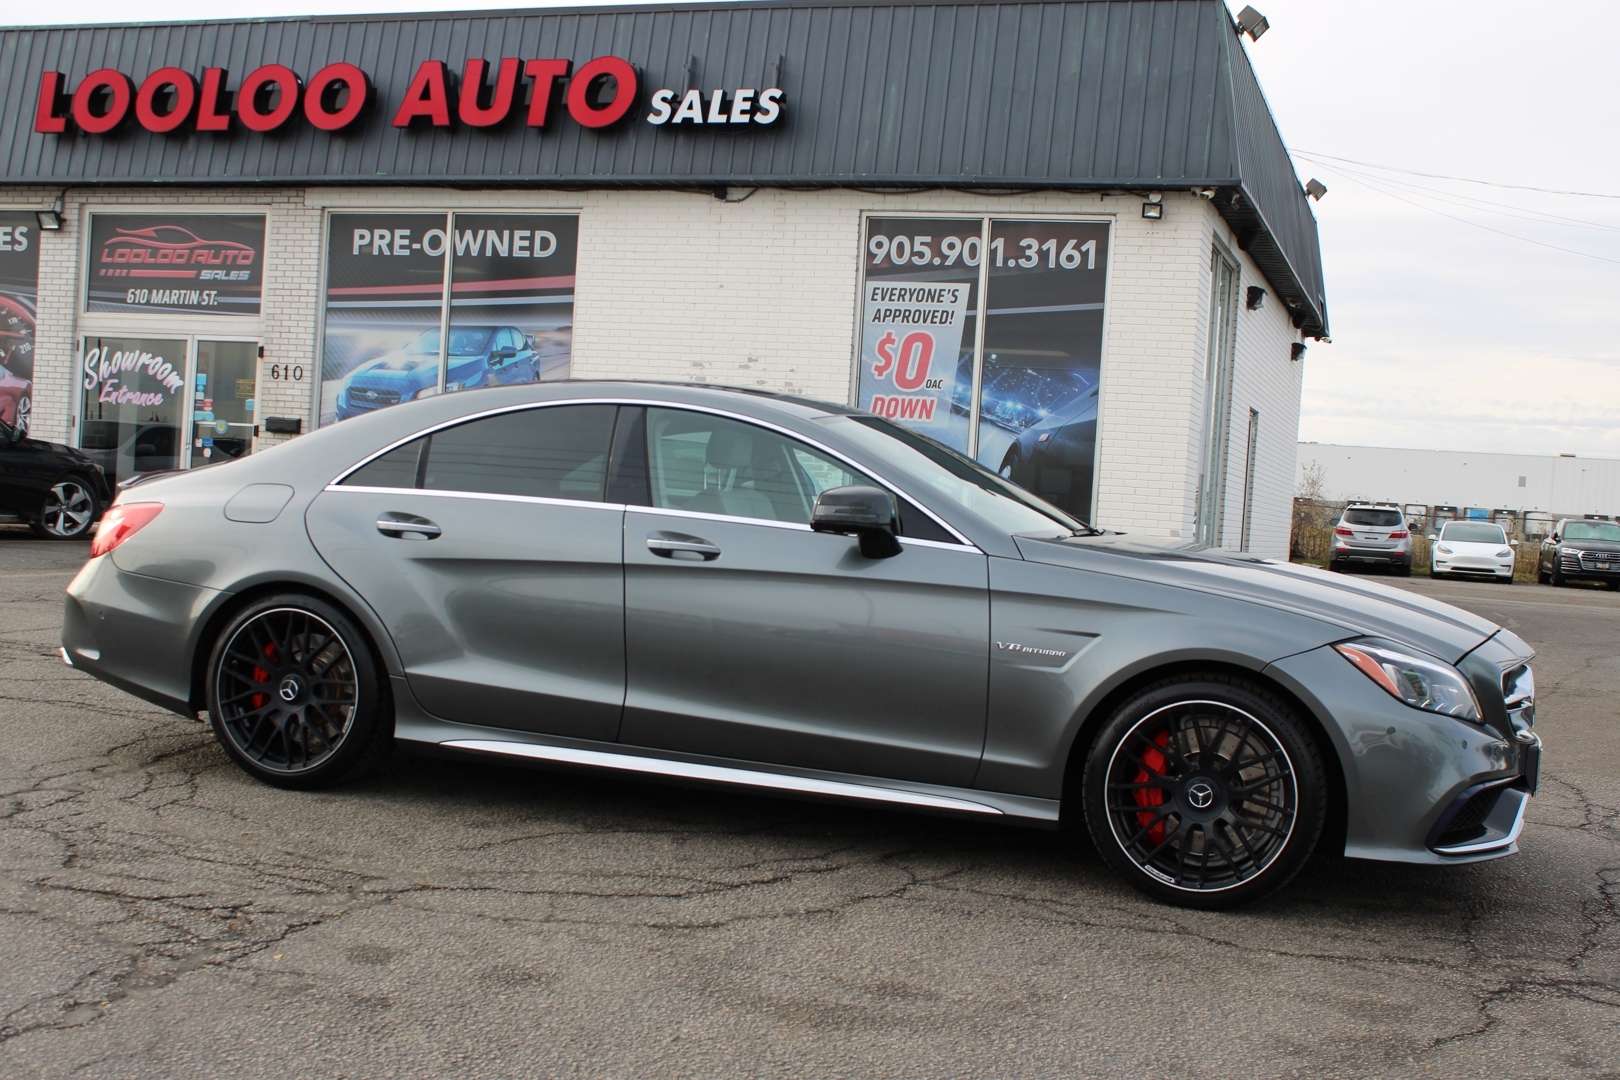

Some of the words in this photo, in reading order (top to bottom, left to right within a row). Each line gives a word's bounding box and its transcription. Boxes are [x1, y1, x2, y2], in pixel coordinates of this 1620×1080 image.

[35, 62, 367, 133] LOOLOO
[391, 56, 637, 128] AUTO
[647, 88, 783, 124] SALES
[352, 228, 557, 258] PRE-OWNED
[869, 234, 1097, 270] 905.901.3161
[101, 248, 188, 265] LOOLOO
[191, 249, 255, 265] AUTO
[200, 270, 251, 281] SALES
[126, 288, 147, 304] 610
[151, 289, 199, 305] MARTIN
[201, 290, 218, 306] ST.
[871, 287, 959, 304] EVERYONE'S
[872, 308, 954, 325] APPROVED!
[874, 331, 934, 389] $0
[84, 346, 184, 394] Showroom
[271, 365, 303, 381] 610
[99, 378, 163, 407] Entrance
[925, 378, 943, 390] OAC
[871, 397, 935, 420] DOWN
[997, 641, 1021, 651] V8
[1022, 647, 1066, 657] BITURBO
